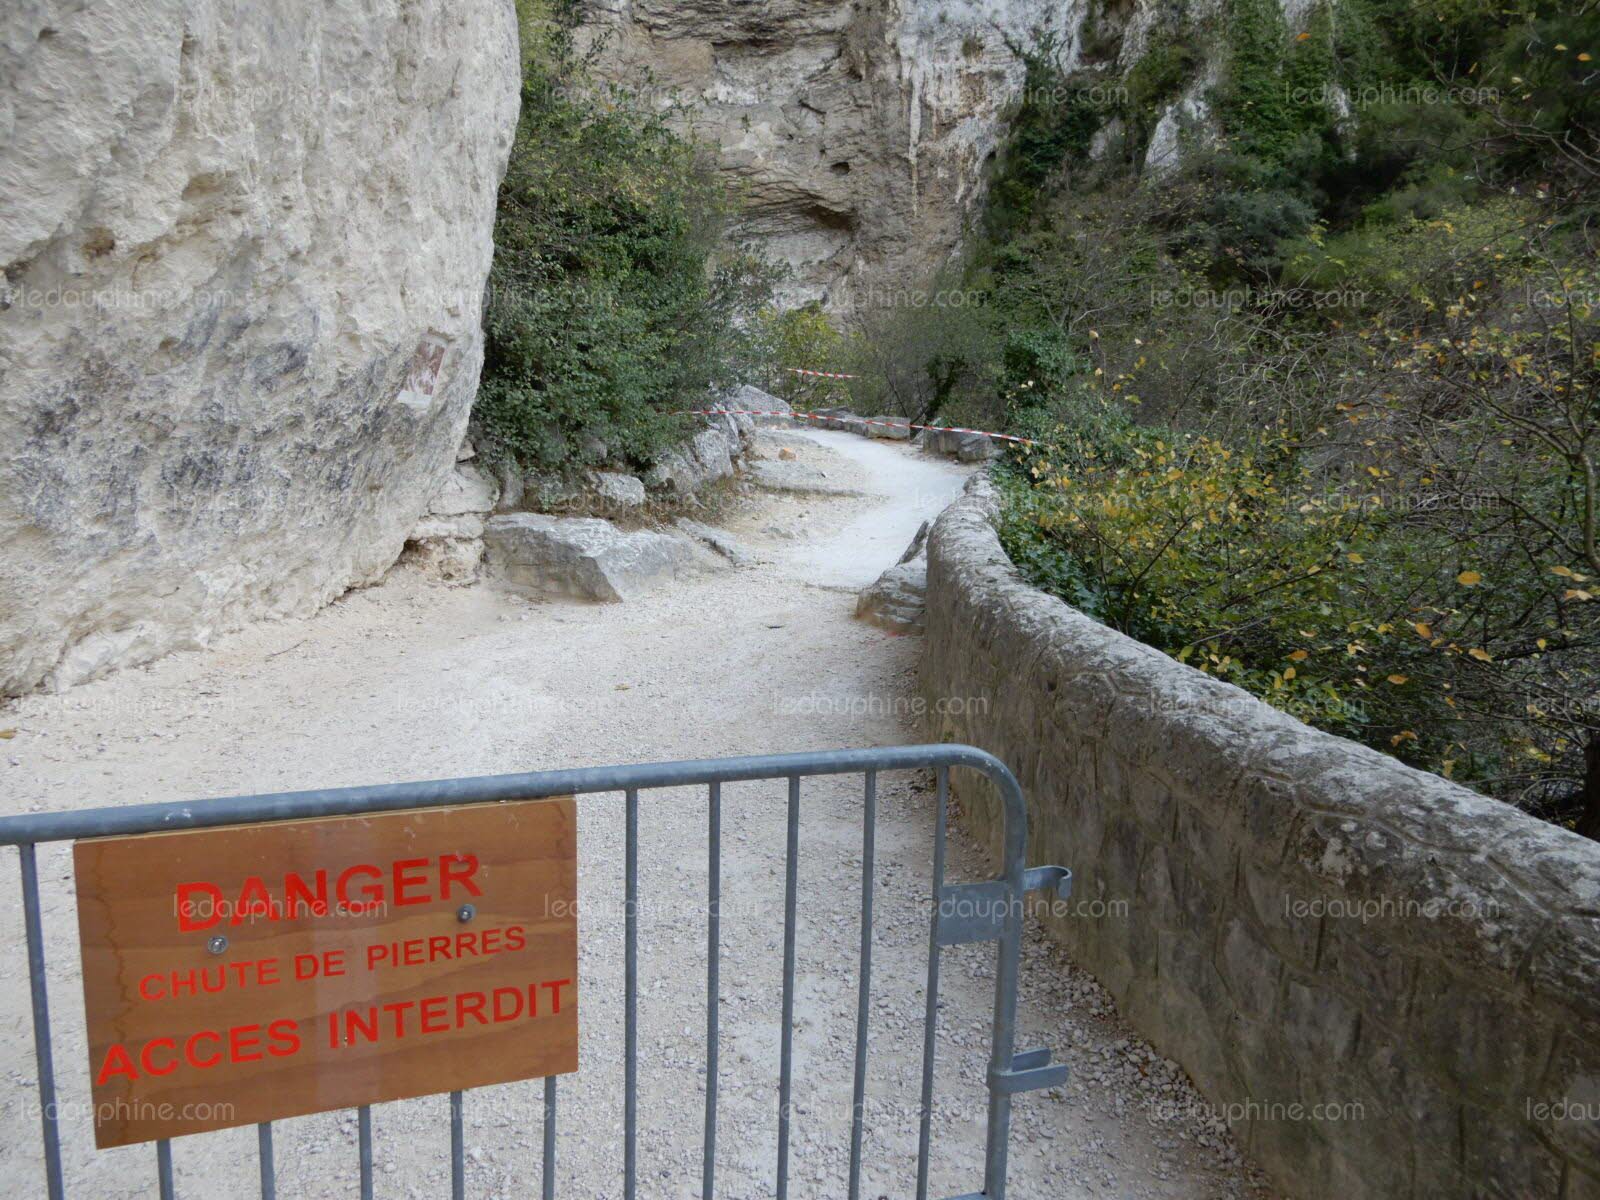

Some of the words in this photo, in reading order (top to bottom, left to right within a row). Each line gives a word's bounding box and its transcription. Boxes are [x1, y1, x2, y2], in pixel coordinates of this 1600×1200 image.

[177, 853, 485, 933] DANGER
[138, 958, 281, 1002] CHUTE
[294, 950, 346, 982] DE
[367, 926, 526, 971] PIERRES
[96, 1018, 301, 1086] ACCES
[329, 979, 571, 1049] INTERDIT
